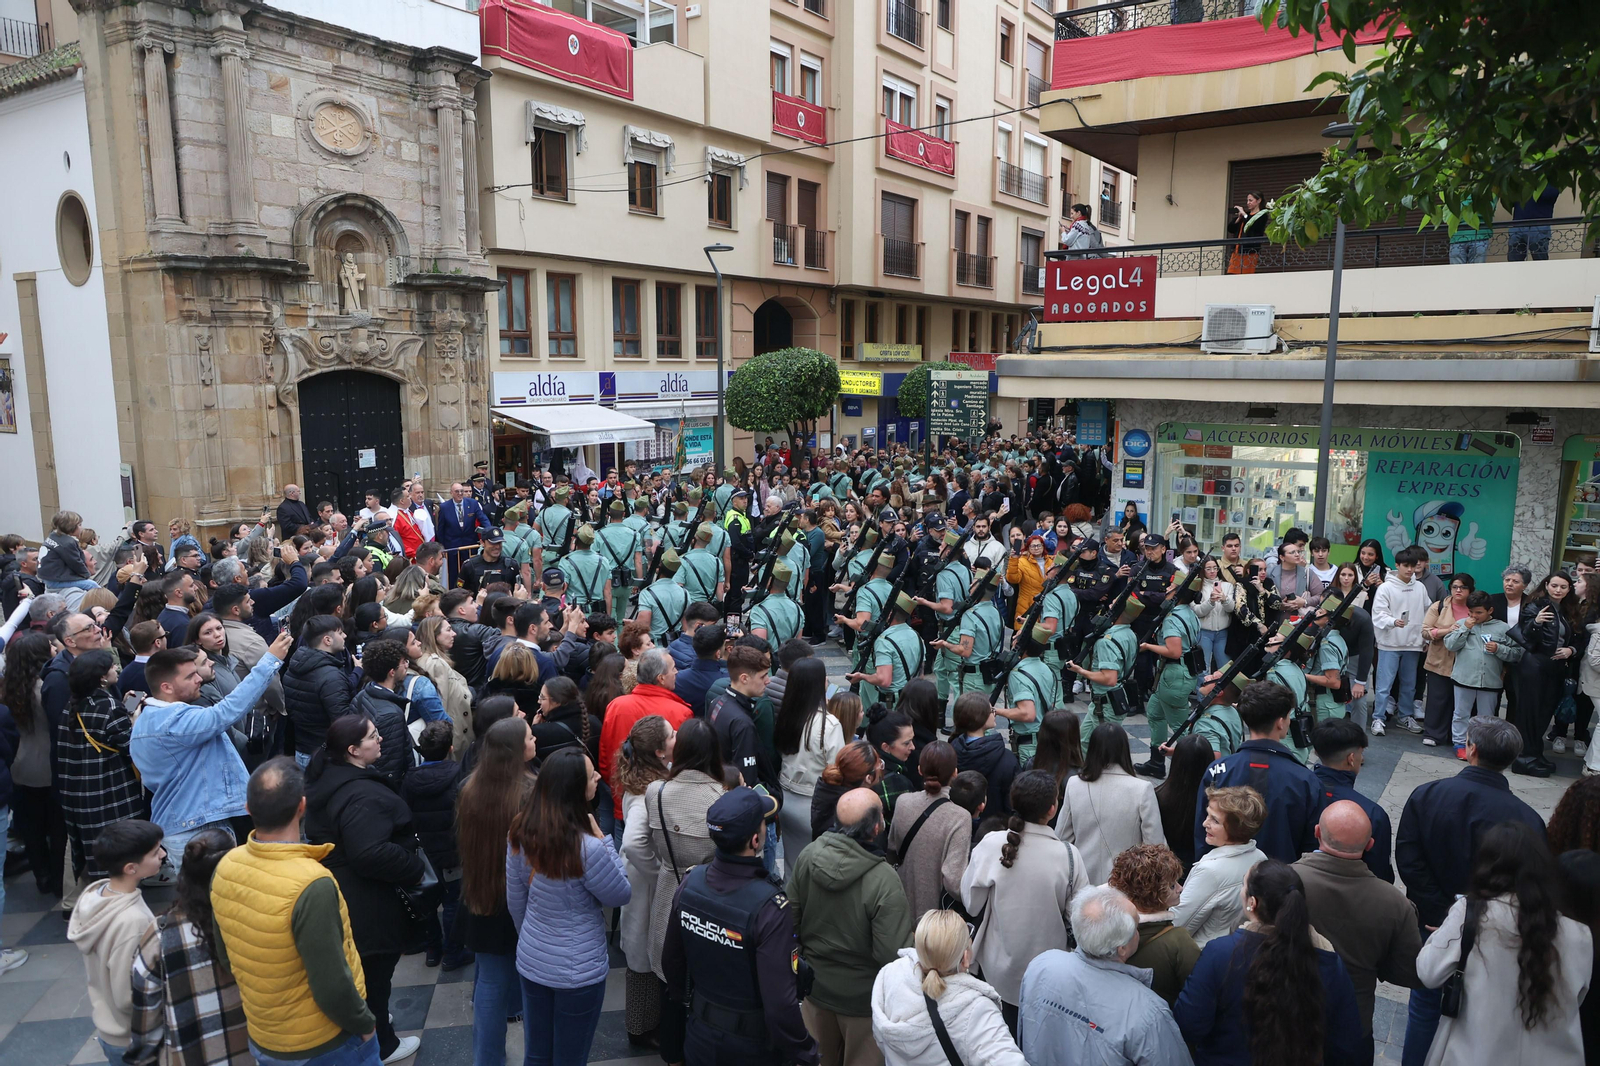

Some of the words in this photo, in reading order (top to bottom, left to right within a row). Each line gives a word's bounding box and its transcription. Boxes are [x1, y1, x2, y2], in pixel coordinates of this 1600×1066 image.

[1055, 266, 1144, 295] Legal4
[1051, 300, 1147, 315] ABOGADOS
[528, 374, 566, 396] aldía
[660, 372, 688, 392] aldía
[1206, 430, 1310, 446] ACCESORIOS
[1317, 433, 1362, 446] ARA
[1370, 432, 1454, 450] MÓVILES
[1375, 459, 1511, 480] REPARACIÓN
[1397, 480, 1482, 498] EXPRESS
[681, 910, 728, 938] POLICIA
[681, 920, 744, 950] NACIONAL
